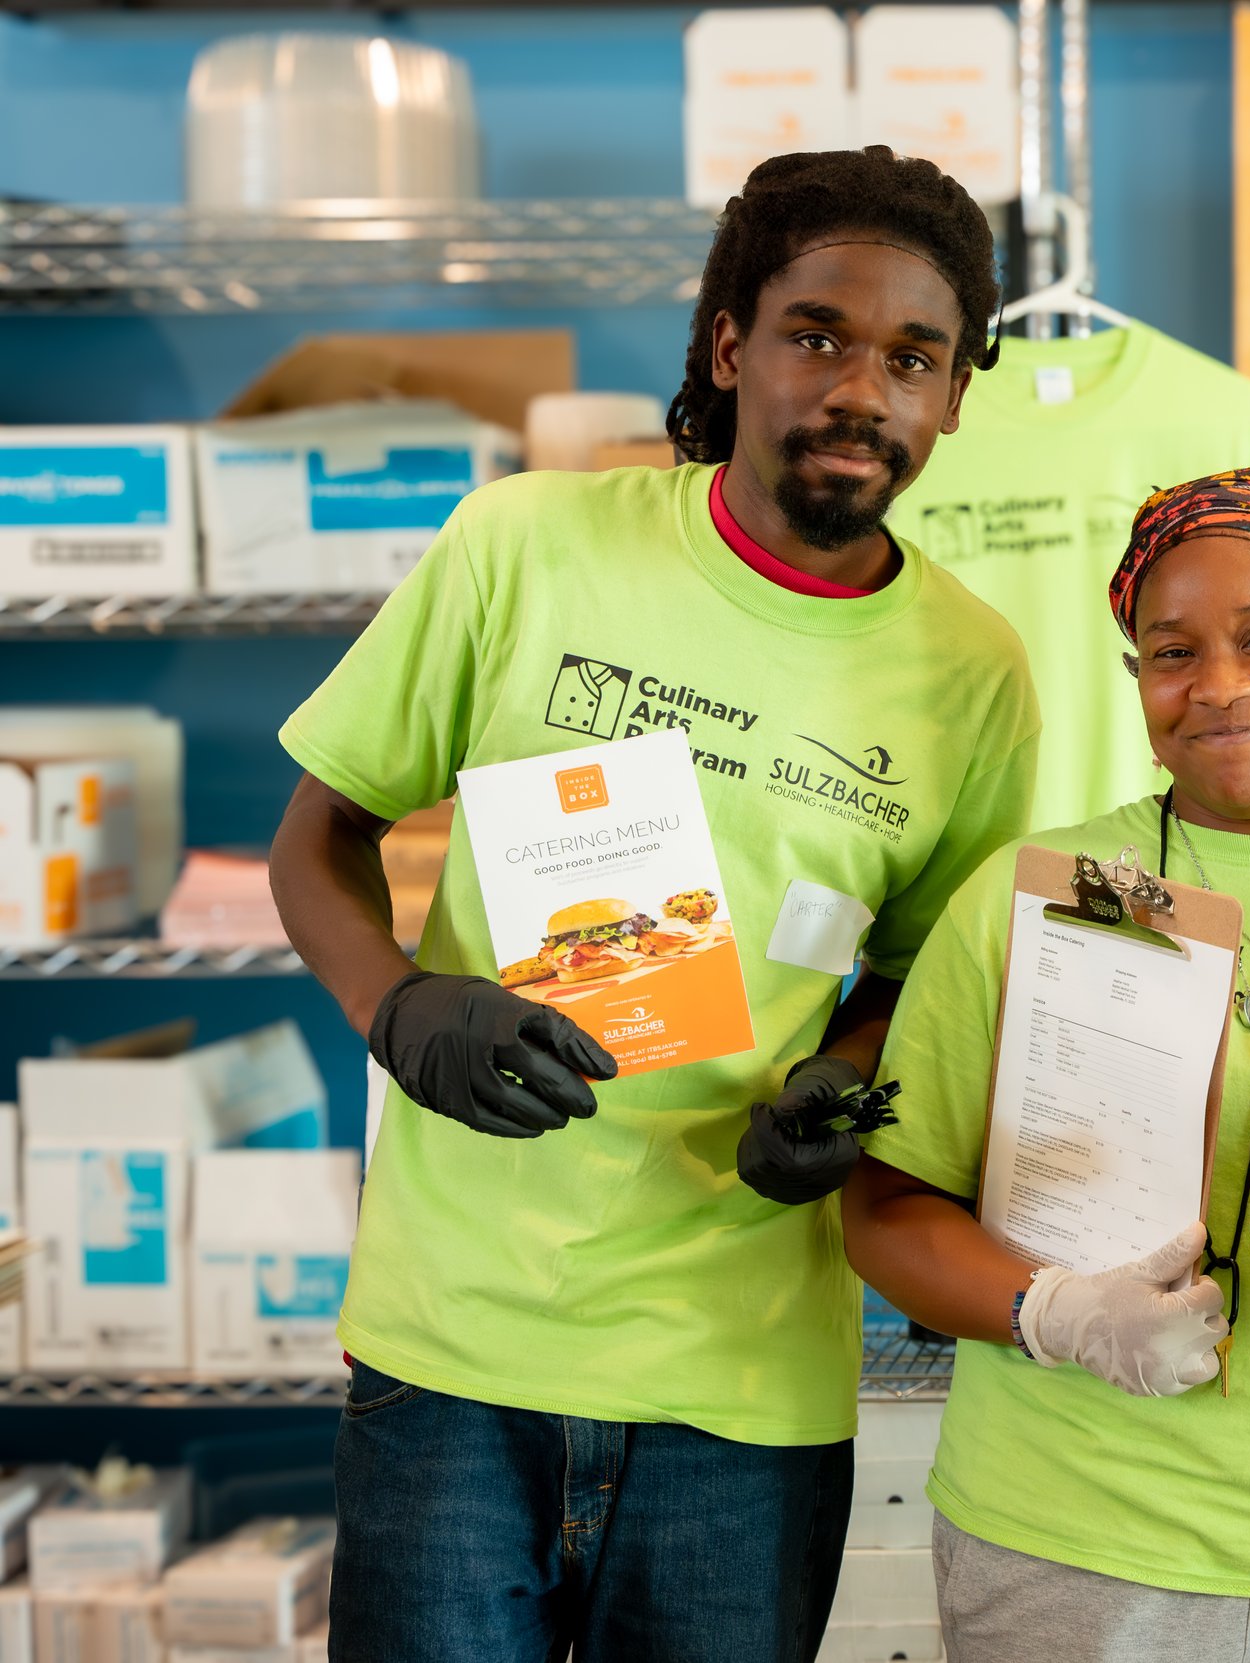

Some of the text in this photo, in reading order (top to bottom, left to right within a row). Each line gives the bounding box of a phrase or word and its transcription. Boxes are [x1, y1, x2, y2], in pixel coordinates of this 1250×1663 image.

[629, 700, 693, 735] Arts
[638, 676, 759, 732] Culinary
[565, 775, 595, 785] INSIDE
[569, 790, 598, 802] BOX
[769, 758, 909, 831] SULZBACHER
[765, 782, 902, 844] HOUSING HEALTHCARE HOPE
[505, 814, 680, 864] CATERING MENU
[534, 863, 563, 876] GOOD
[565, 857, 596, 870] FOOD.
[597, 849, 630, 863] DOING
[632, 842, 663, 856] GOOD.
[603, 1019, 665, 1040] SULZBACHER
[617, 1059, 630, 1067] ALL
[637, 1046, 646, 1055] AT
